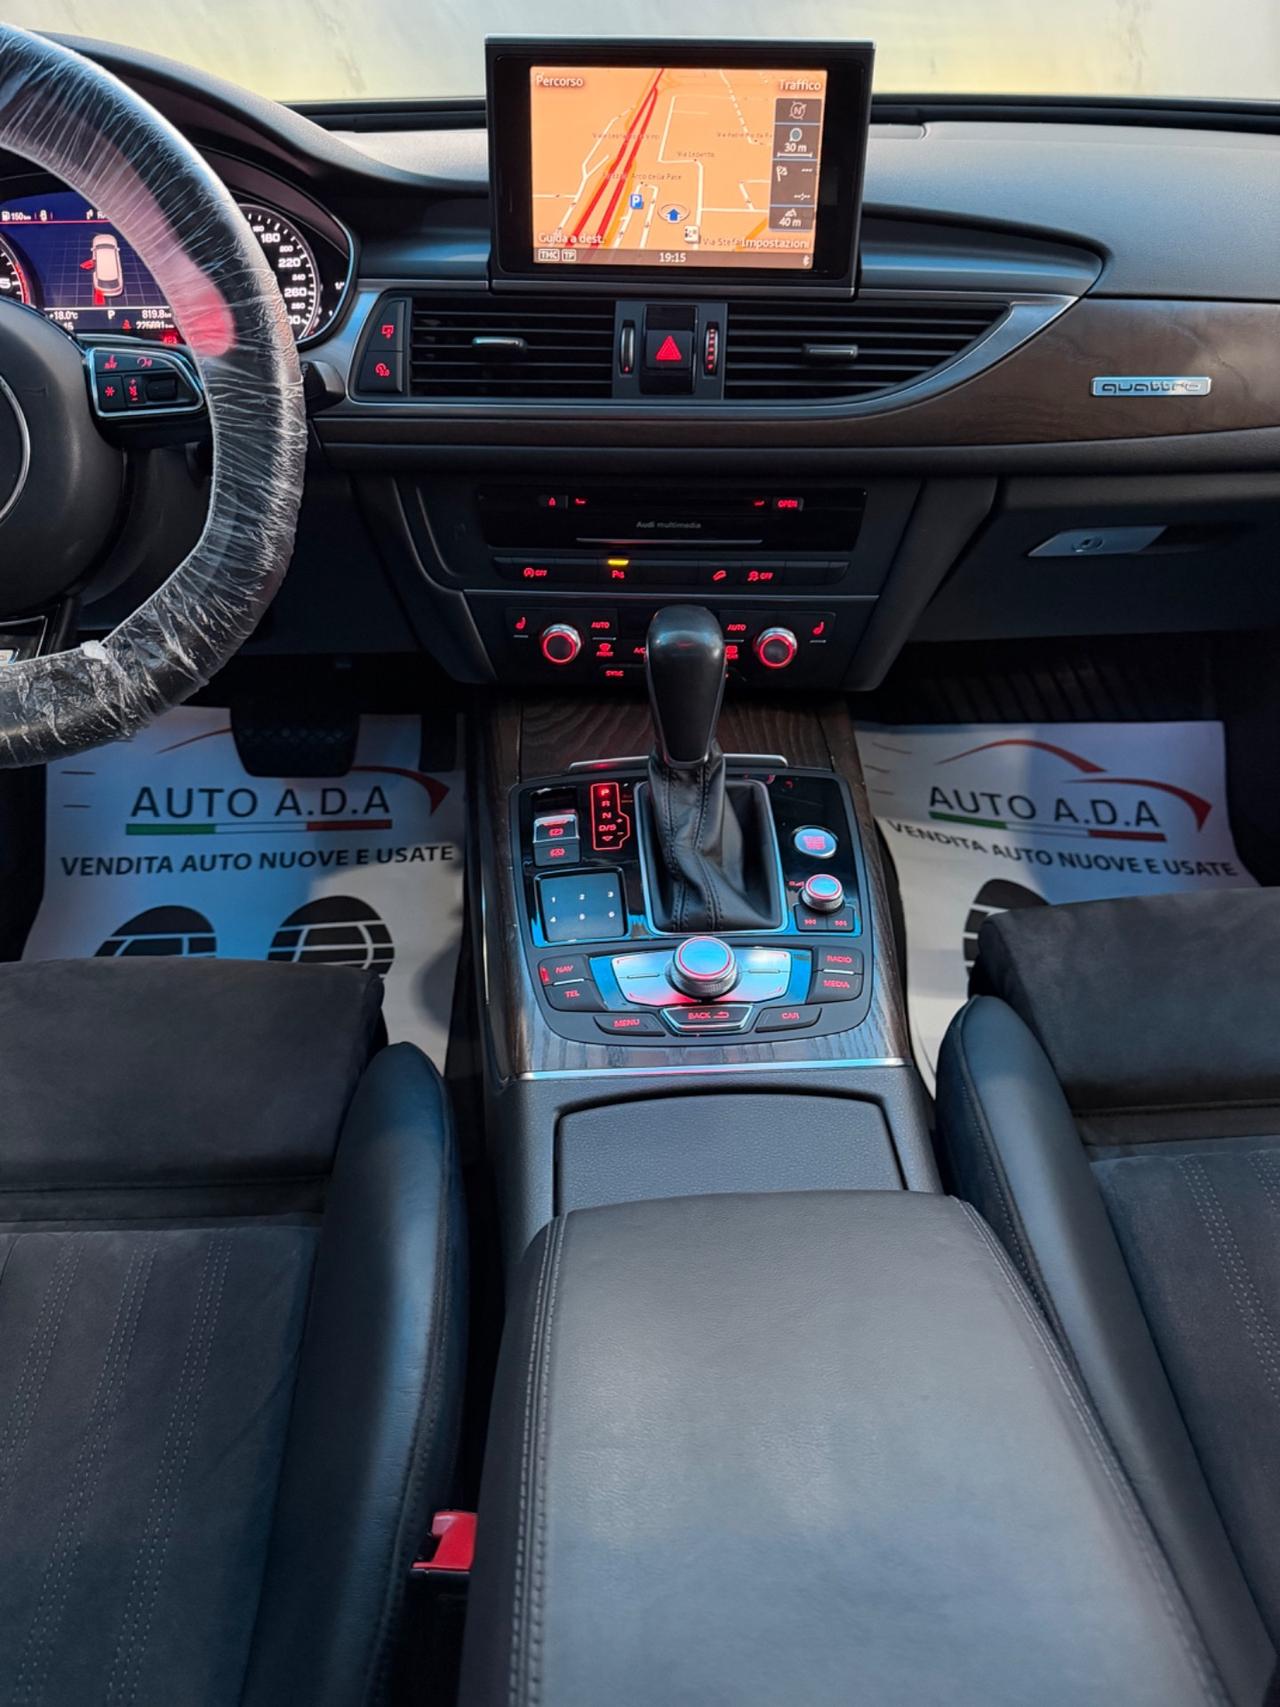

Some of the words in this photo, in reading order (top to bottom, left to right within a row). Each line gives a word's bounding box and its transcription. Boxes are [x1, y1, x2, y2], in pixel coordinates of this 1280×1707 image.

[536, 74, 583, 87] Percorso
[779, 79, 822, 92] Traffico
[784, 143, 797, 152] 30
[779, 217, 792, 227] 40
[261, 233, 280, 243] 180
[569, 234, 577, 244] a
[659, 252, 687, 263] 19:15
[278, 258, 301, 268] 220
[284, 288, 307, 298] 260
[107, 311, 116, 320] P
[1101, 381, 1201, 394] quattro
[636, 520, 656, 529] Audi
[656, 521, 702, 529] multimedia
[591, 621, 610, 629] AUTO
[727, 623, 747, 631] AUTO
[130, 786, 259, 818] AUTO
[274, 785, 391, 817] A.D.A
[928, 786, 1037, 819] AUTO
[1053, 798, 1162, 828] A.D.A
[887, 819, 988, 854] VENDITA
[992, 841, 1053, 867] AUTO
[1058, 851, 1146, 875] NUOVE
[1148, 857, 1161, 875] E
[1162, 858, 1239, 878] USATE
[61, 854, 174, 877] VENDITA
[181, 852, 253, 873] AUTO
[259, 849, 349, 870] NUOVE
[356, 848, 370, 866] E
[376, 845, 455, 864] USATE
[826, 954, 853, 964] RADIO
[555, 965, 574, 974] NAV
[823, 979, 850, 988] MEDIA
[564, 989, 580, 998] TEL
[687, 1011, 712, 1020] BACK
[780, 1011, 800, 1020] CAR
[613, 1018, 641, 1028] MENU
